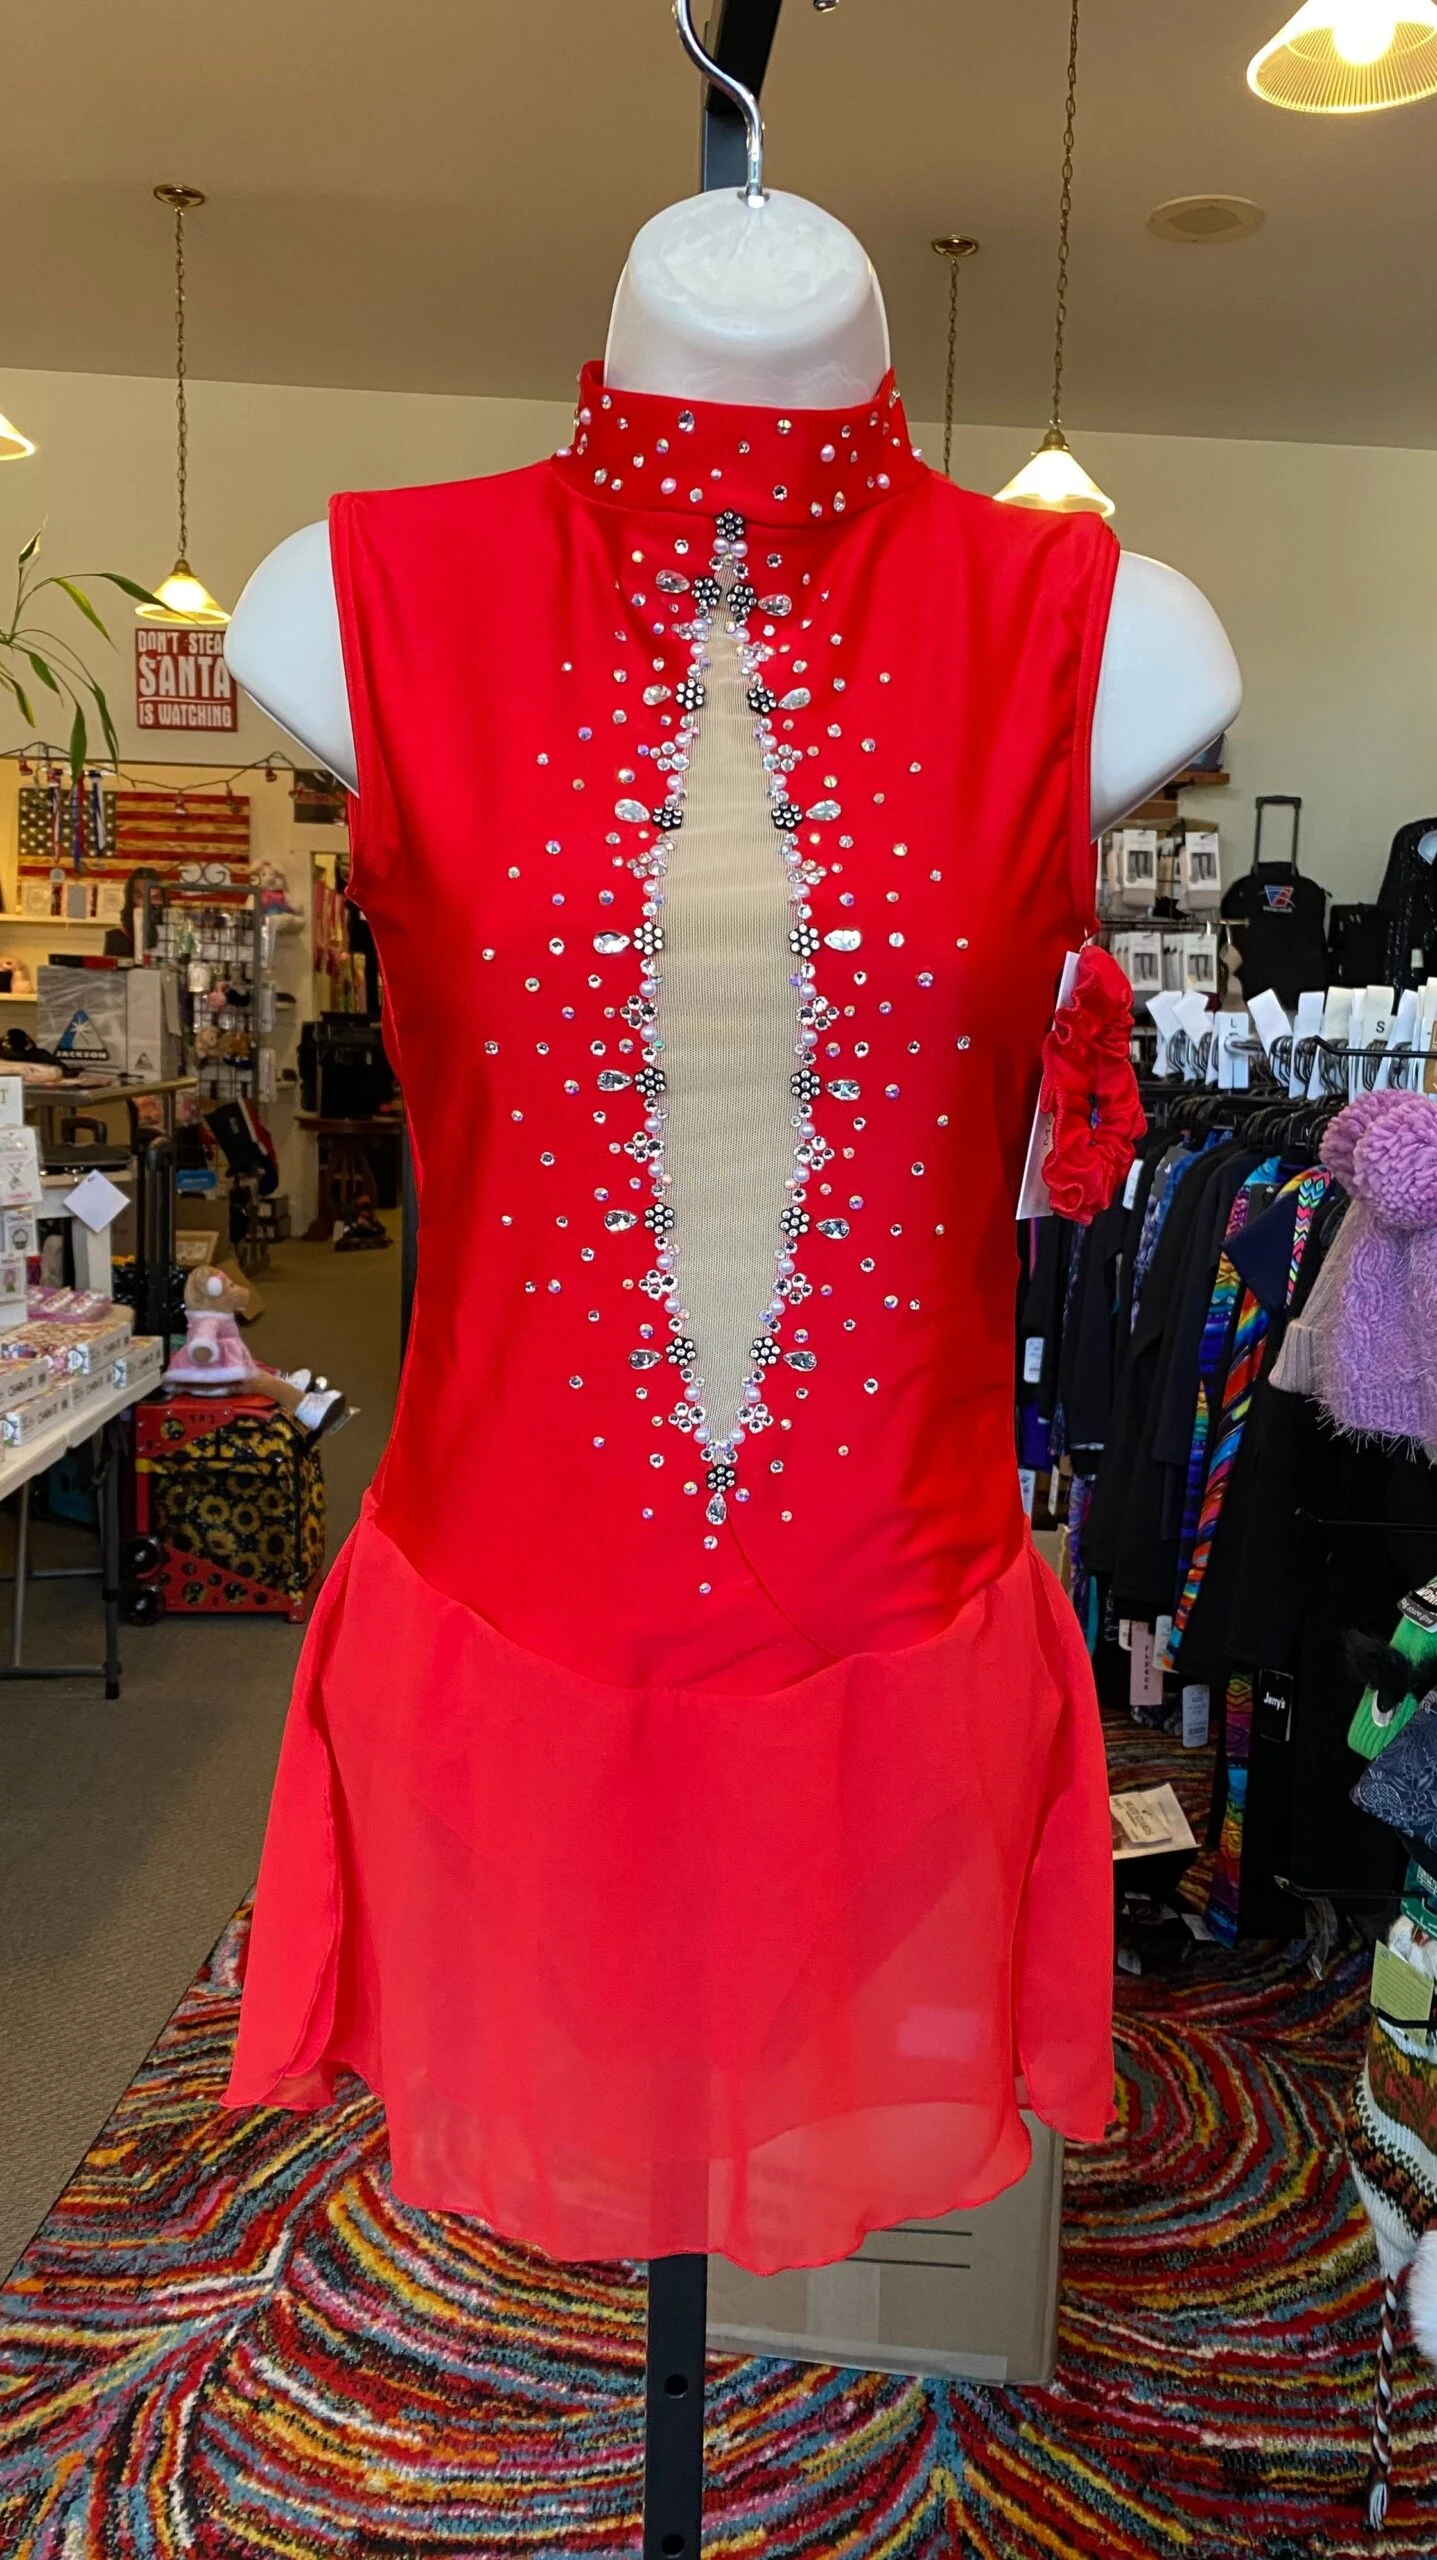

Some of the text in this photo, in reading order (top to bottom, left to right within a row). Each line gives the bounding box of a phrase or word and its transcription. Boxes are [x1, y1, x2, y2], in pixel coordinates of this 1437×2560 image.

[138, 631, 223, 655] DON'T STEA
[138, 654, 231, 698] SANTA
[139, 703, 232, 727] IS WATCHING
[1230, 1018, 1237, 1029] L
[1375, 1020, 1385, 1034] S
[56, 1050, 107, 1059] JACKSON
[1263, 1691, 1286, 1711] Jerry's
